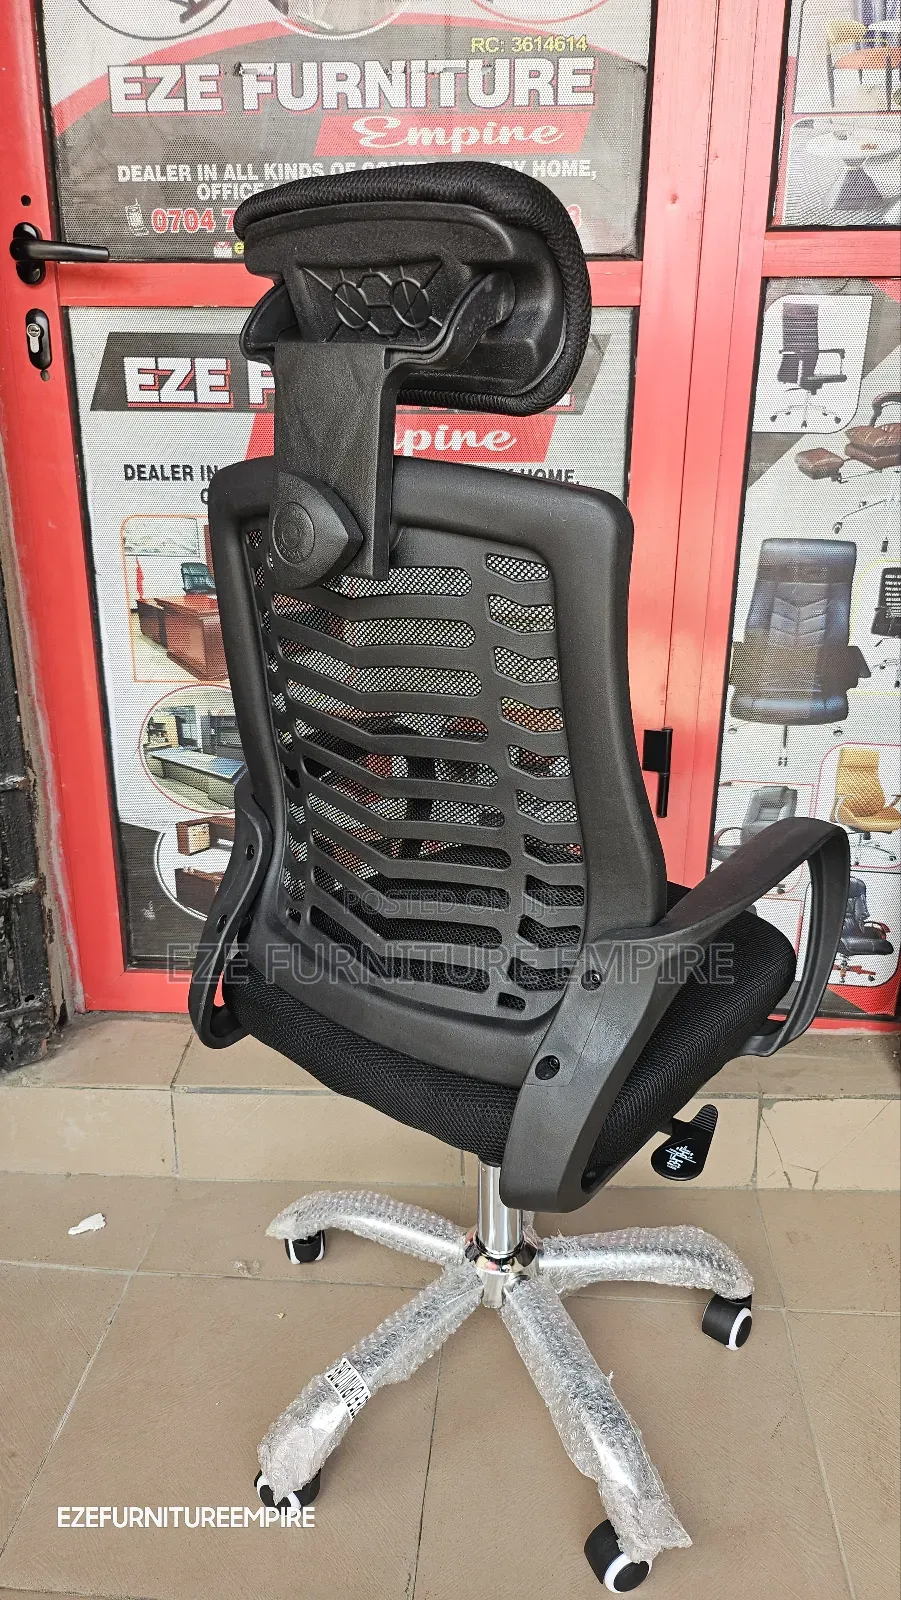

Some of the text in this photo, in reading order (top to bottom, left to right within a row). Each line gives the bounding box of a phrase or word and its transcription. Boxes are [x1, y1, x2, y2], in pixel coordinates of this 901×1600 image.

[471, 35, 588, 53] RC: 3614614
[108, 56, 598, 115] EZE FURNITURE
[352, 115, 565, 153] Empire
[117, 165, 192, 183] DEALER
[197, 164, 219, 182] IN
[223, 163, 259, 181] ALL
[264, 162, 325, 180] KINDS
[532, 160, 597, 181] HOME,
[152, 208, 216, 234] 0704
[123, 356, 234, 408] EZE
[394, 424, 518, 456] pire
[123, 463, 195, 482] DEALER
